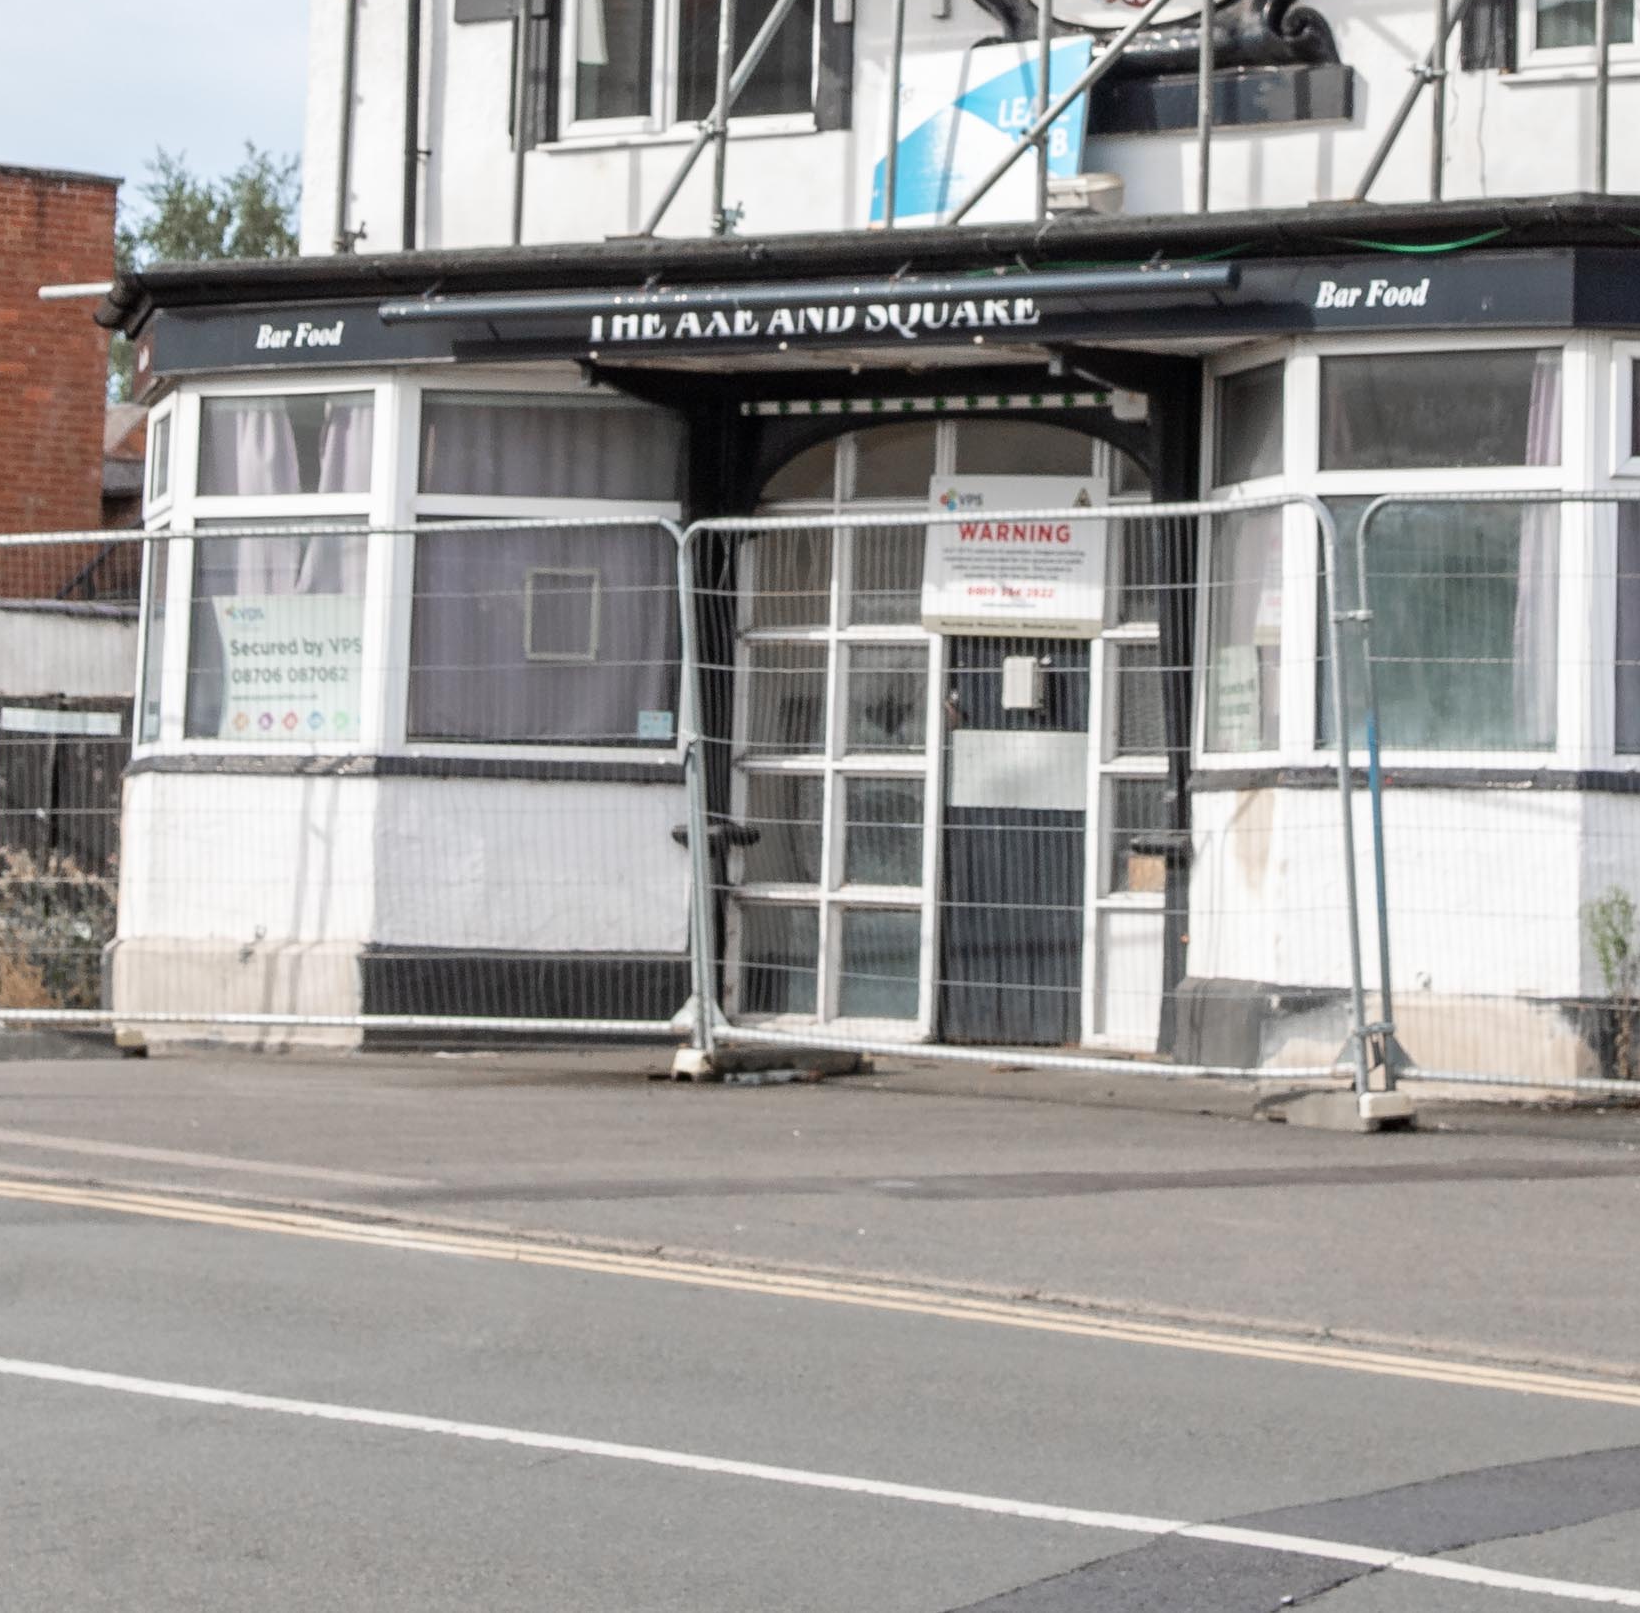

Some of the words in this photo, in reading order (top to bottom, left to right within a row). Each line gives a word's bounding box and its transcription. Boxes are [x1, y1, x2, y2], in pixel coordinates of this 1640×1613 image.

[1314, 280, 1362, 308] Bar
[1364, 277, 1431, 307] Food
[256, 324, 292, 349] Bar
[293, 320, 345, 348] Food
[589, 313, 667, 343] THE
[673, 309, 760, 339] AXE
[765, 305, 856, 336] AND
[958, 521, 1072, 544] WARNING
[230, 639, 298, 657] Secured
[302, 638, 323, 658] by
[328, 637, 362, 654] VPS
